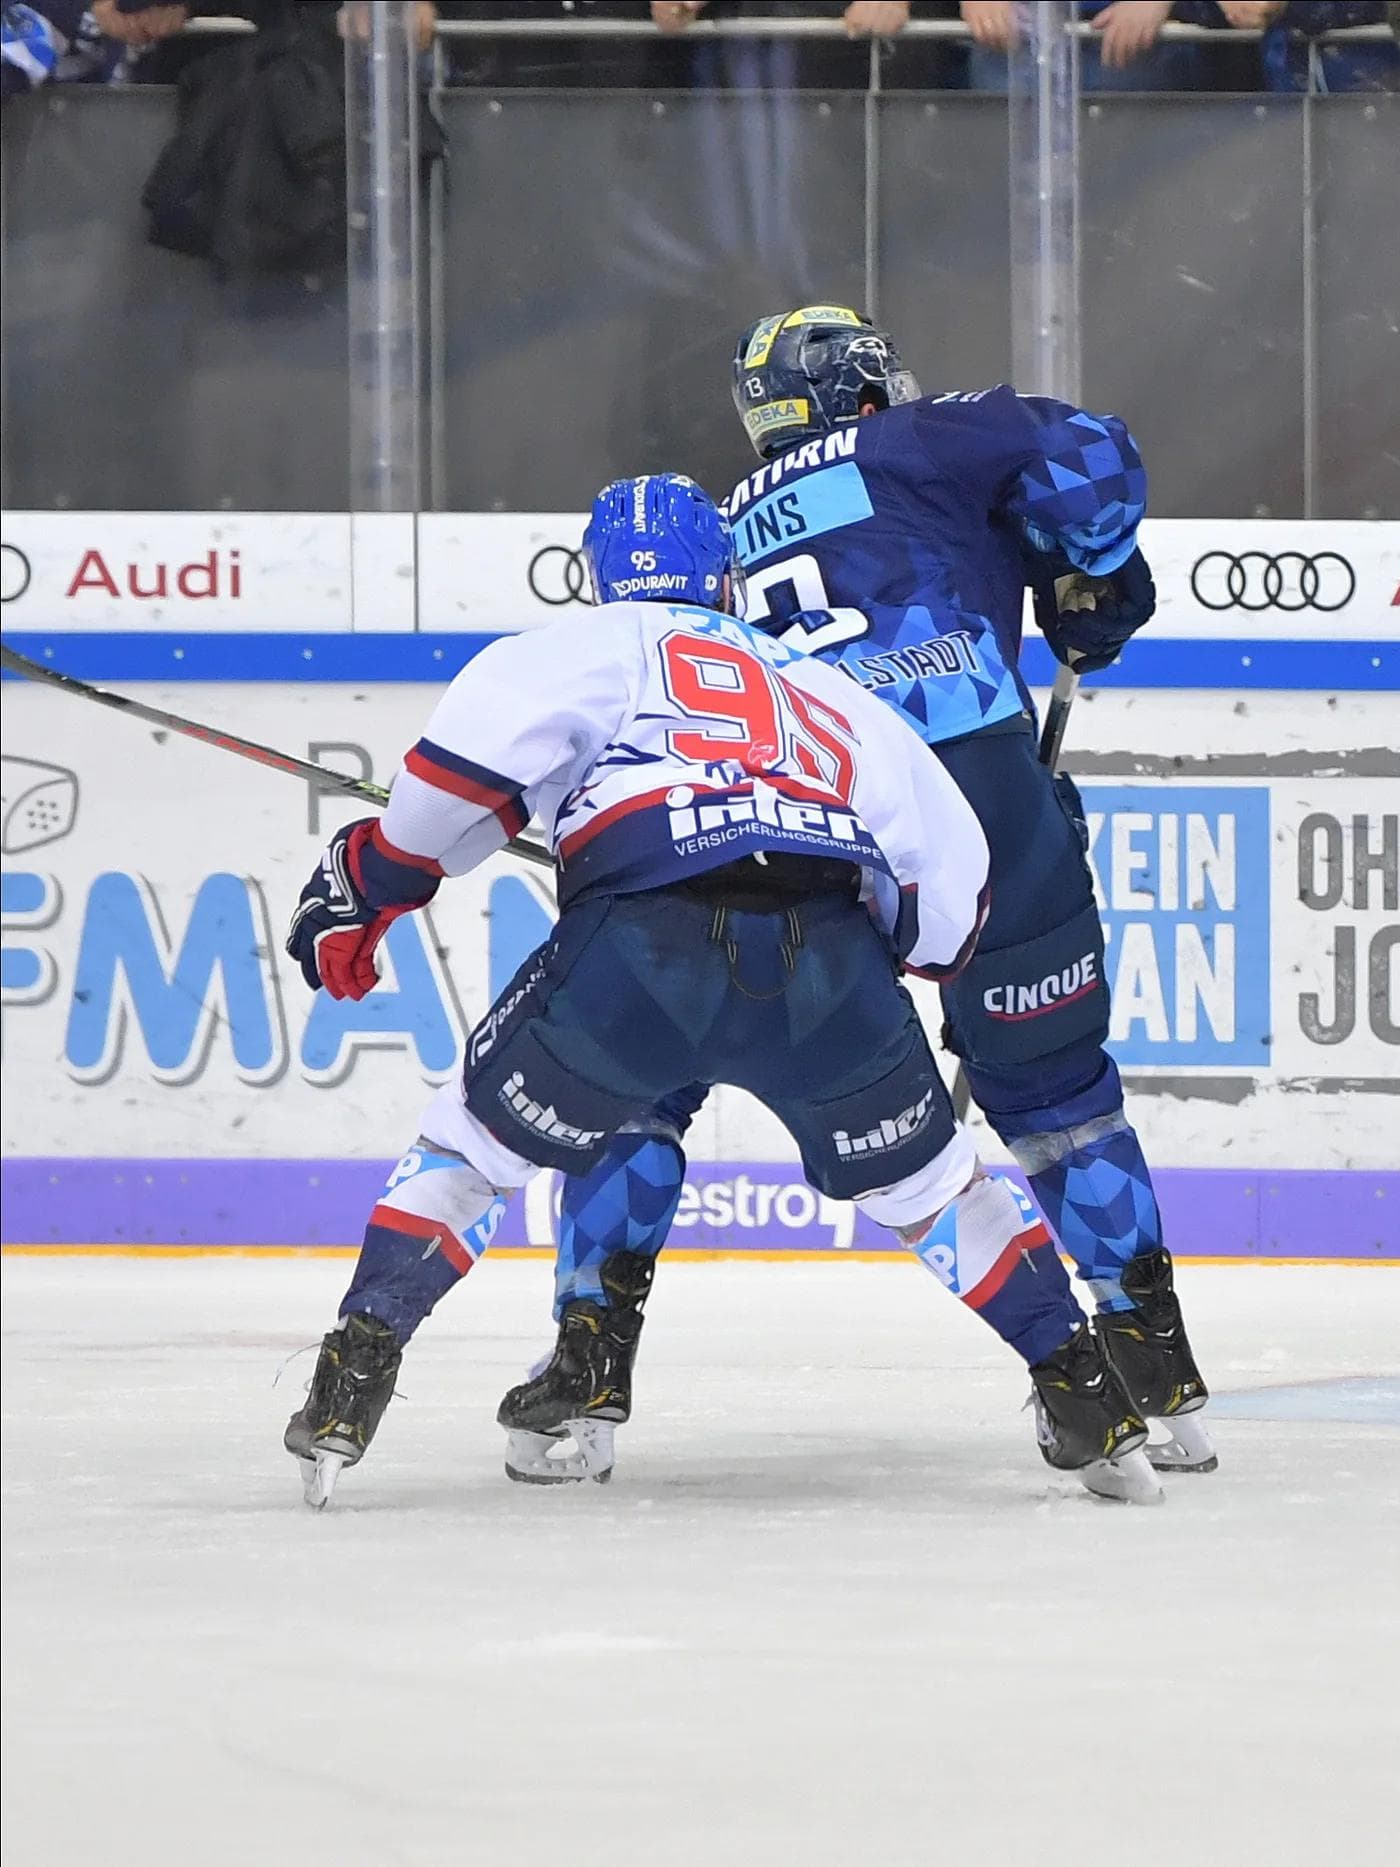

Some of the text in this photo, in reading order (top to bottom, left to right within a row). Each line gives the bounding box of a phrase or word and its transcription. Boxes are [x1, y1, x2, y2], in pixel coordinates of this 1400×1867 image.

[746, 377, 765, 398] 13
[66, 549, 241, 598] Audi
[630, 549, 657, 571] 95
[632, 573, 688, 592] DURAVIT
[666, 785, 869, 841] inter
[674, 822, 883, 860] VERSICHERUNGSGRUPPE
[982, 950, 1098, 1015] CINQUE
[1104, 922, 1236, 1042] AN
[501, 1070, 606, 1146] inter
[832, 1087, 933, 1155] inter
